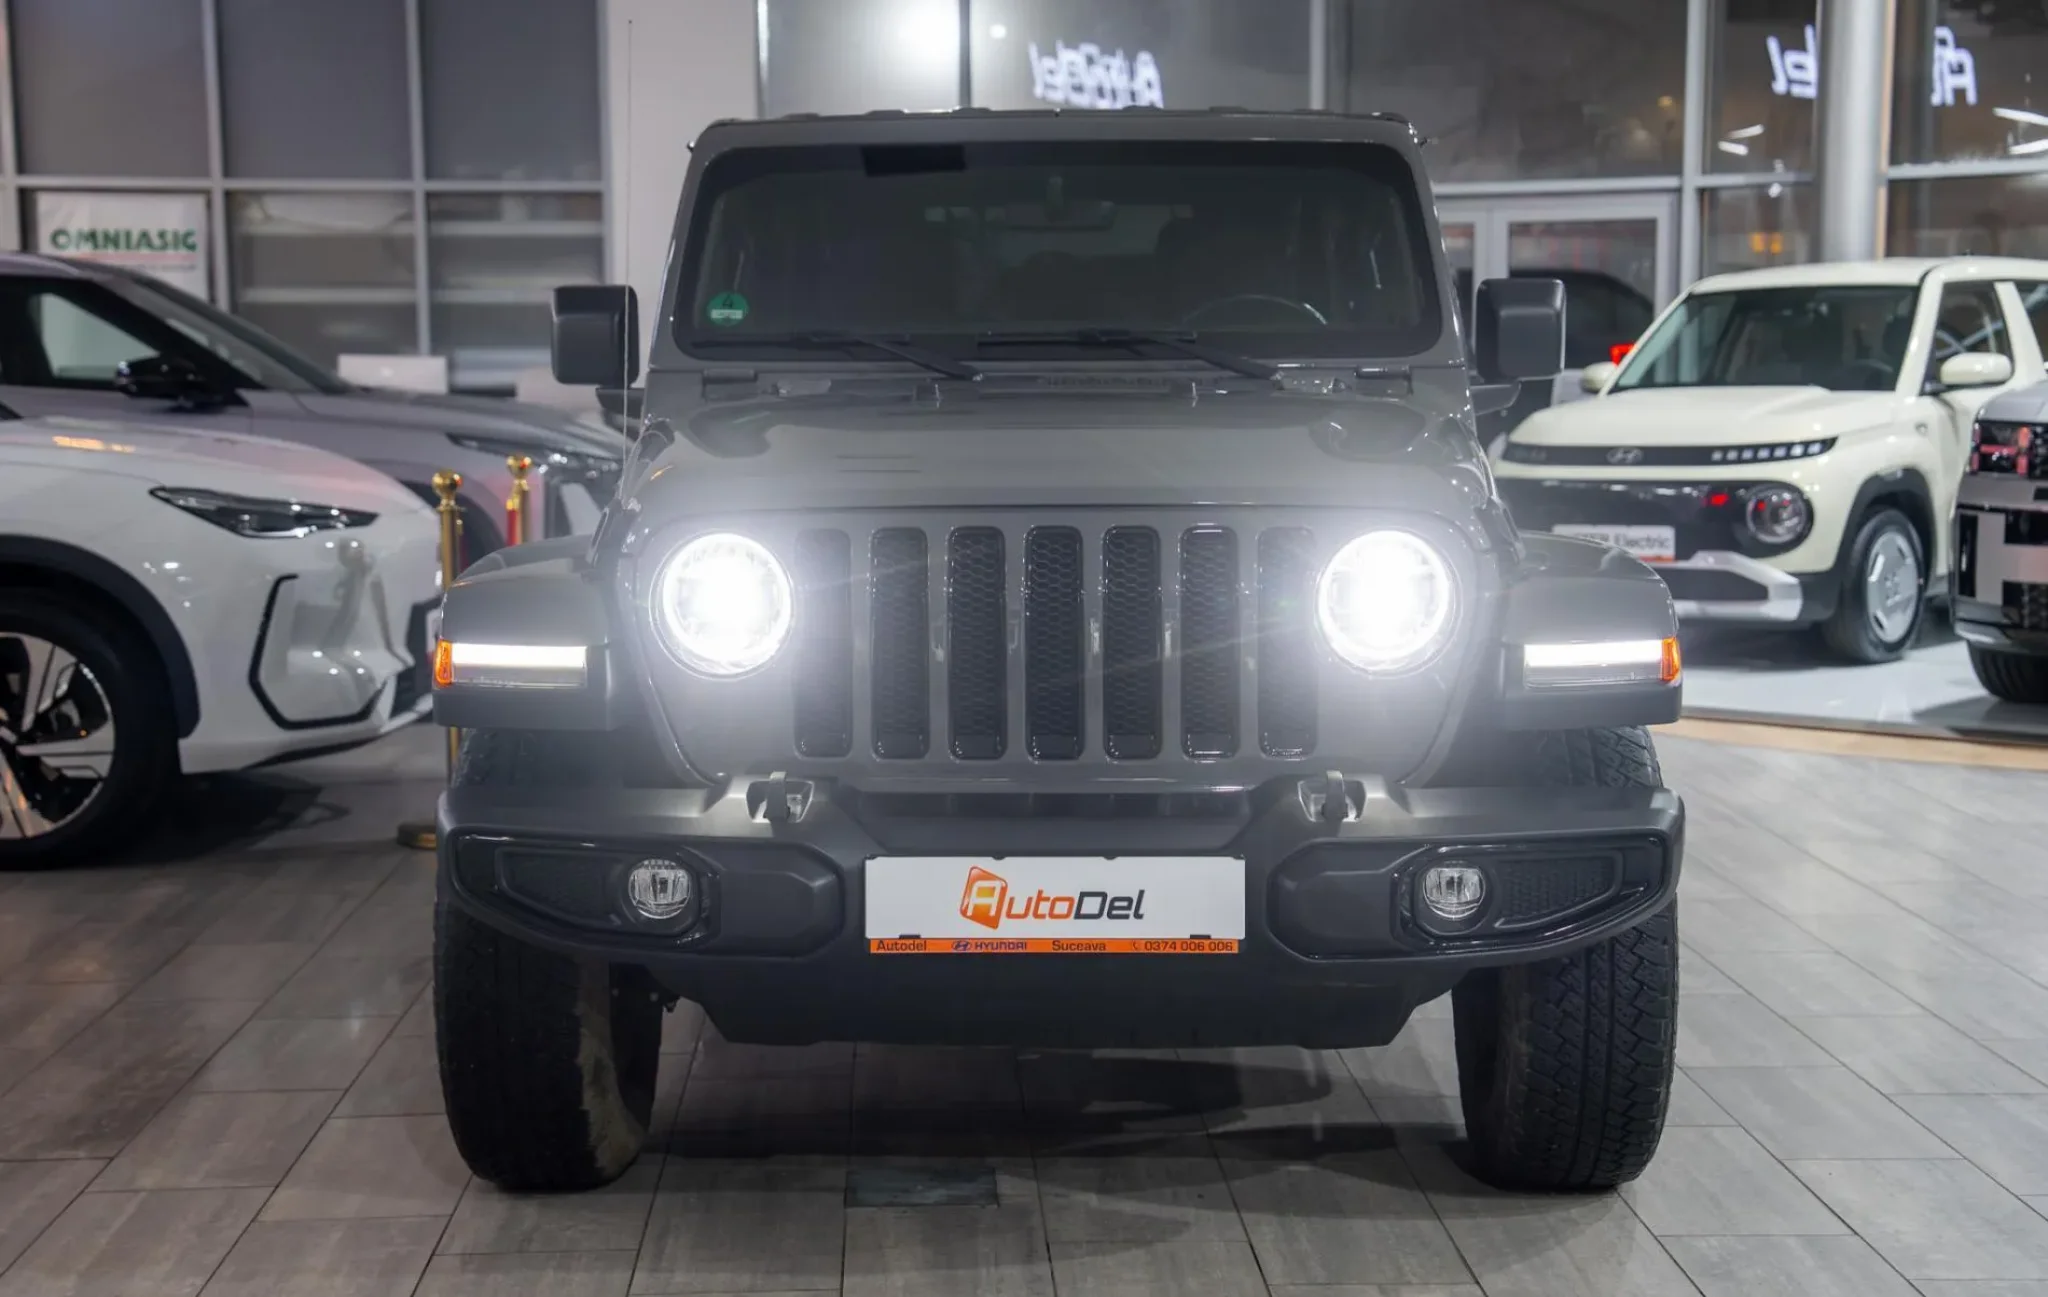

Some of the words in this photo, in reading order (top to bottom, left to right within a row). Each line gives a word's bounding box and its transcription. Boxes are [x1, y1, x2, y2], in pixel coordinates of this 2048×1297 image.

[968, 879, 1145, 920] AutoDel
[876, 940, 927, 951] Autodel
[974, 942, 1027, 951] HYUNDAI
[1052, 940, 1106, 952] Suceava
[1144, 941, 1177, 951] 0374
[1180, 941, 1205, 951] 006
[1208, 941, 1233, 951] 006
